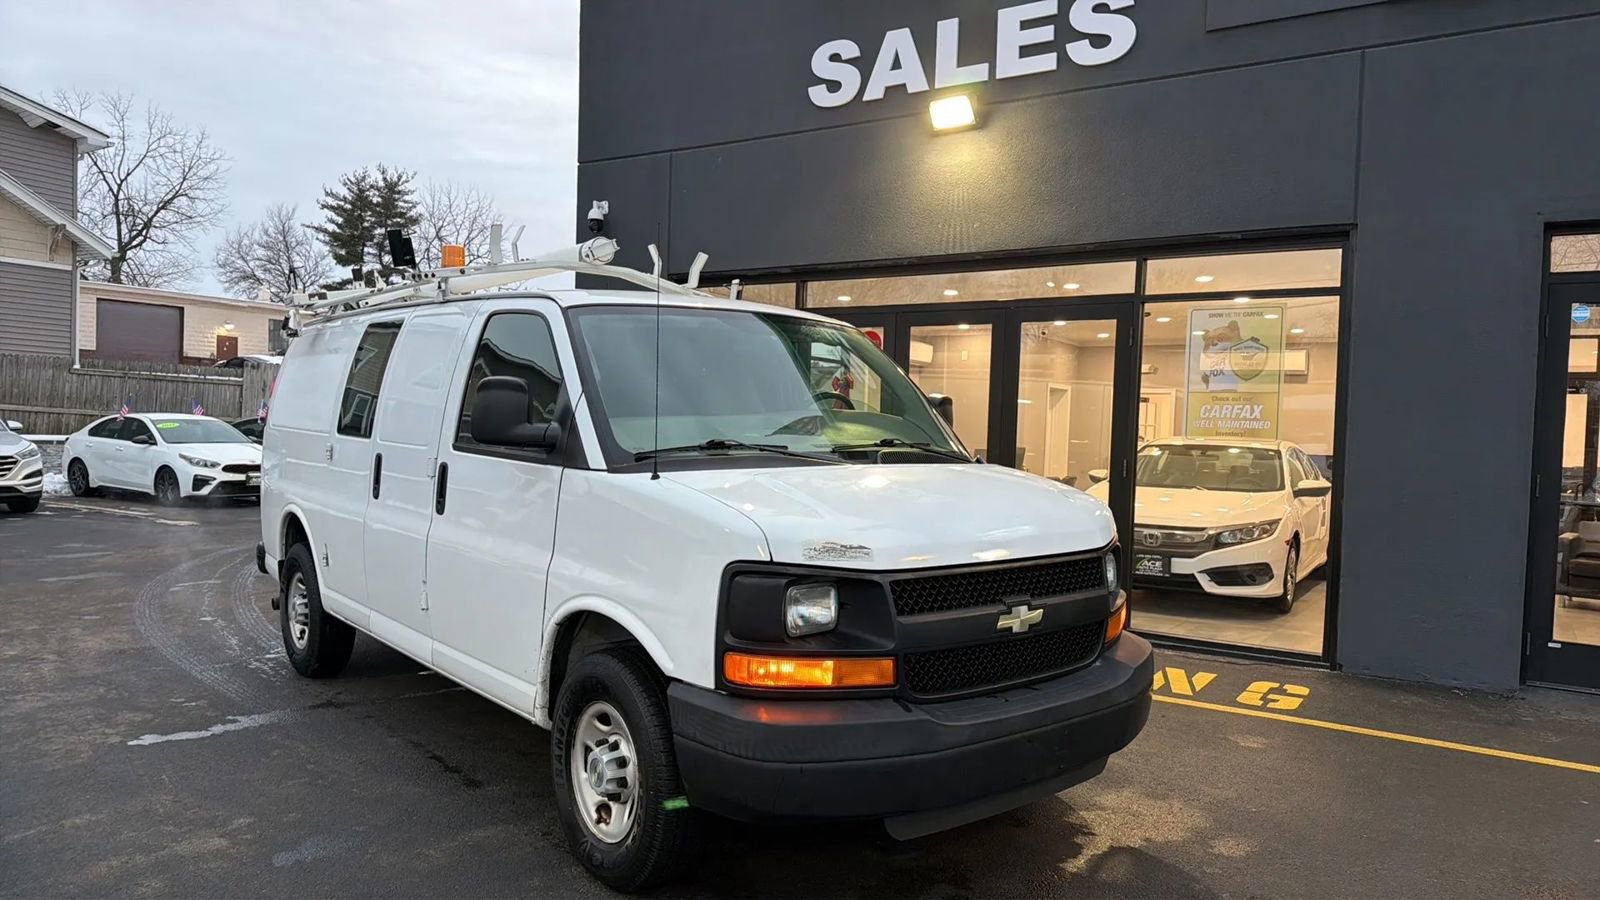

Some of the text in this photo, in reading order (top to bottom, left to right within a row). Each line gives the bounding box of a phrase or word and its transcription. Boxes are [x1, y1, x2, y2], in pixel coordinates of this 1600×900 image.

[807, 0, 1137, 108] SALES
[1199, 404, 1264, 419] CARFAX
[1193, 420, 1271, 429] WELL MAINTAINED
